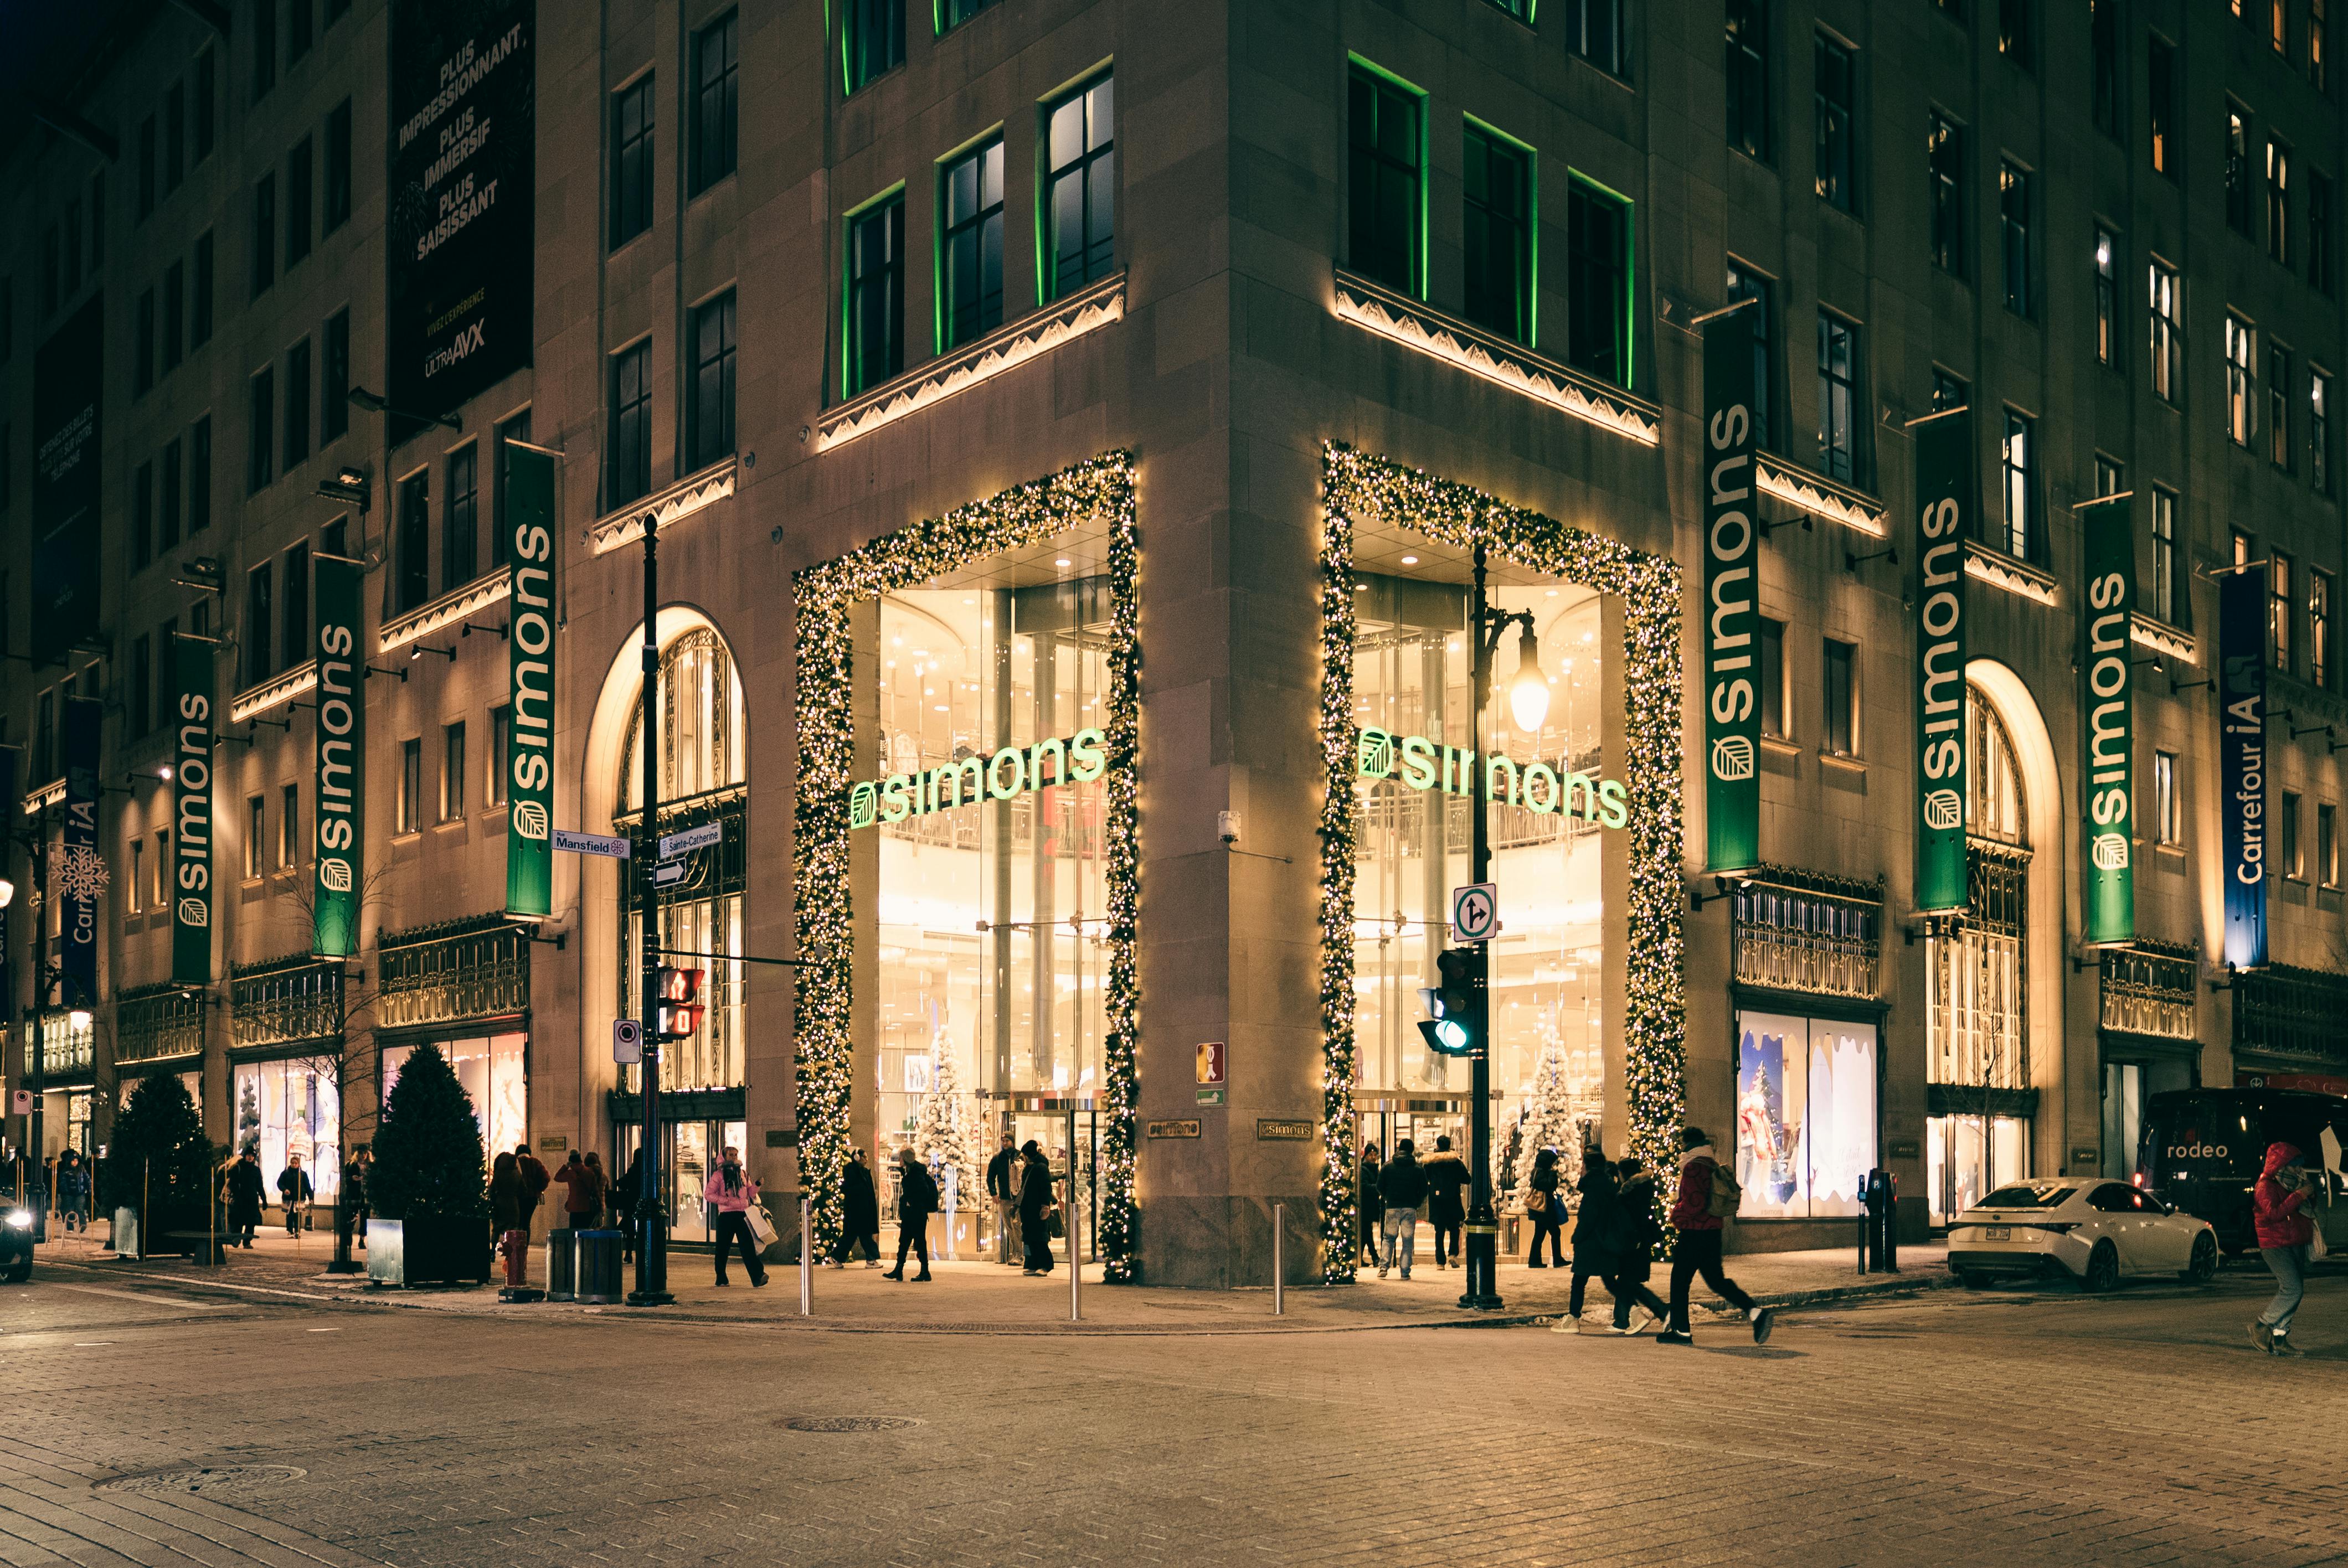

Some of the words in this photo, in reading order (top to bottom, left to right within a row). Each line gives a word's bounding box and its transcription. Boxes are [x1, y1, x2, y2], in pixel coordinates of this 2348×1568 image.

[399, 22, 521, 151] IMPRESSIONNANT
[440, 39, 475, 89] PLUS
[424, 117, 491, 192] IMMERSIF
[440, 106, 474, 154] PLUS
[417, 178, 498, 261] SAISISSANT
[439, 172, 474, 219] PLUS
[426, 315, 444, 338] VIVEZ
[1710, 404, 1754, 724] simons
[514, 523, 550, 791] simons
[1922, 497, 1961, 780] simons
[321, 624, 353, 850] simons
[2090, 572, 2128, 824] simons
[2226, 695, 2262, 734] iA
[179, 693, 209, 891] simons
[882, 728, 1105, 823] simons
[1402, 735, 1628, 829] simons
[2237, 743, 2262, 885] Carrefour
[69, 801, 95, 831] iA
[557, 837, 609, 853] Mansfield
[669, 831, 718, 852] Sainte-Catherine
[1268, 1125, 1311, 1135] simons
[2167, 1141, 2228, 1158] rodeo
